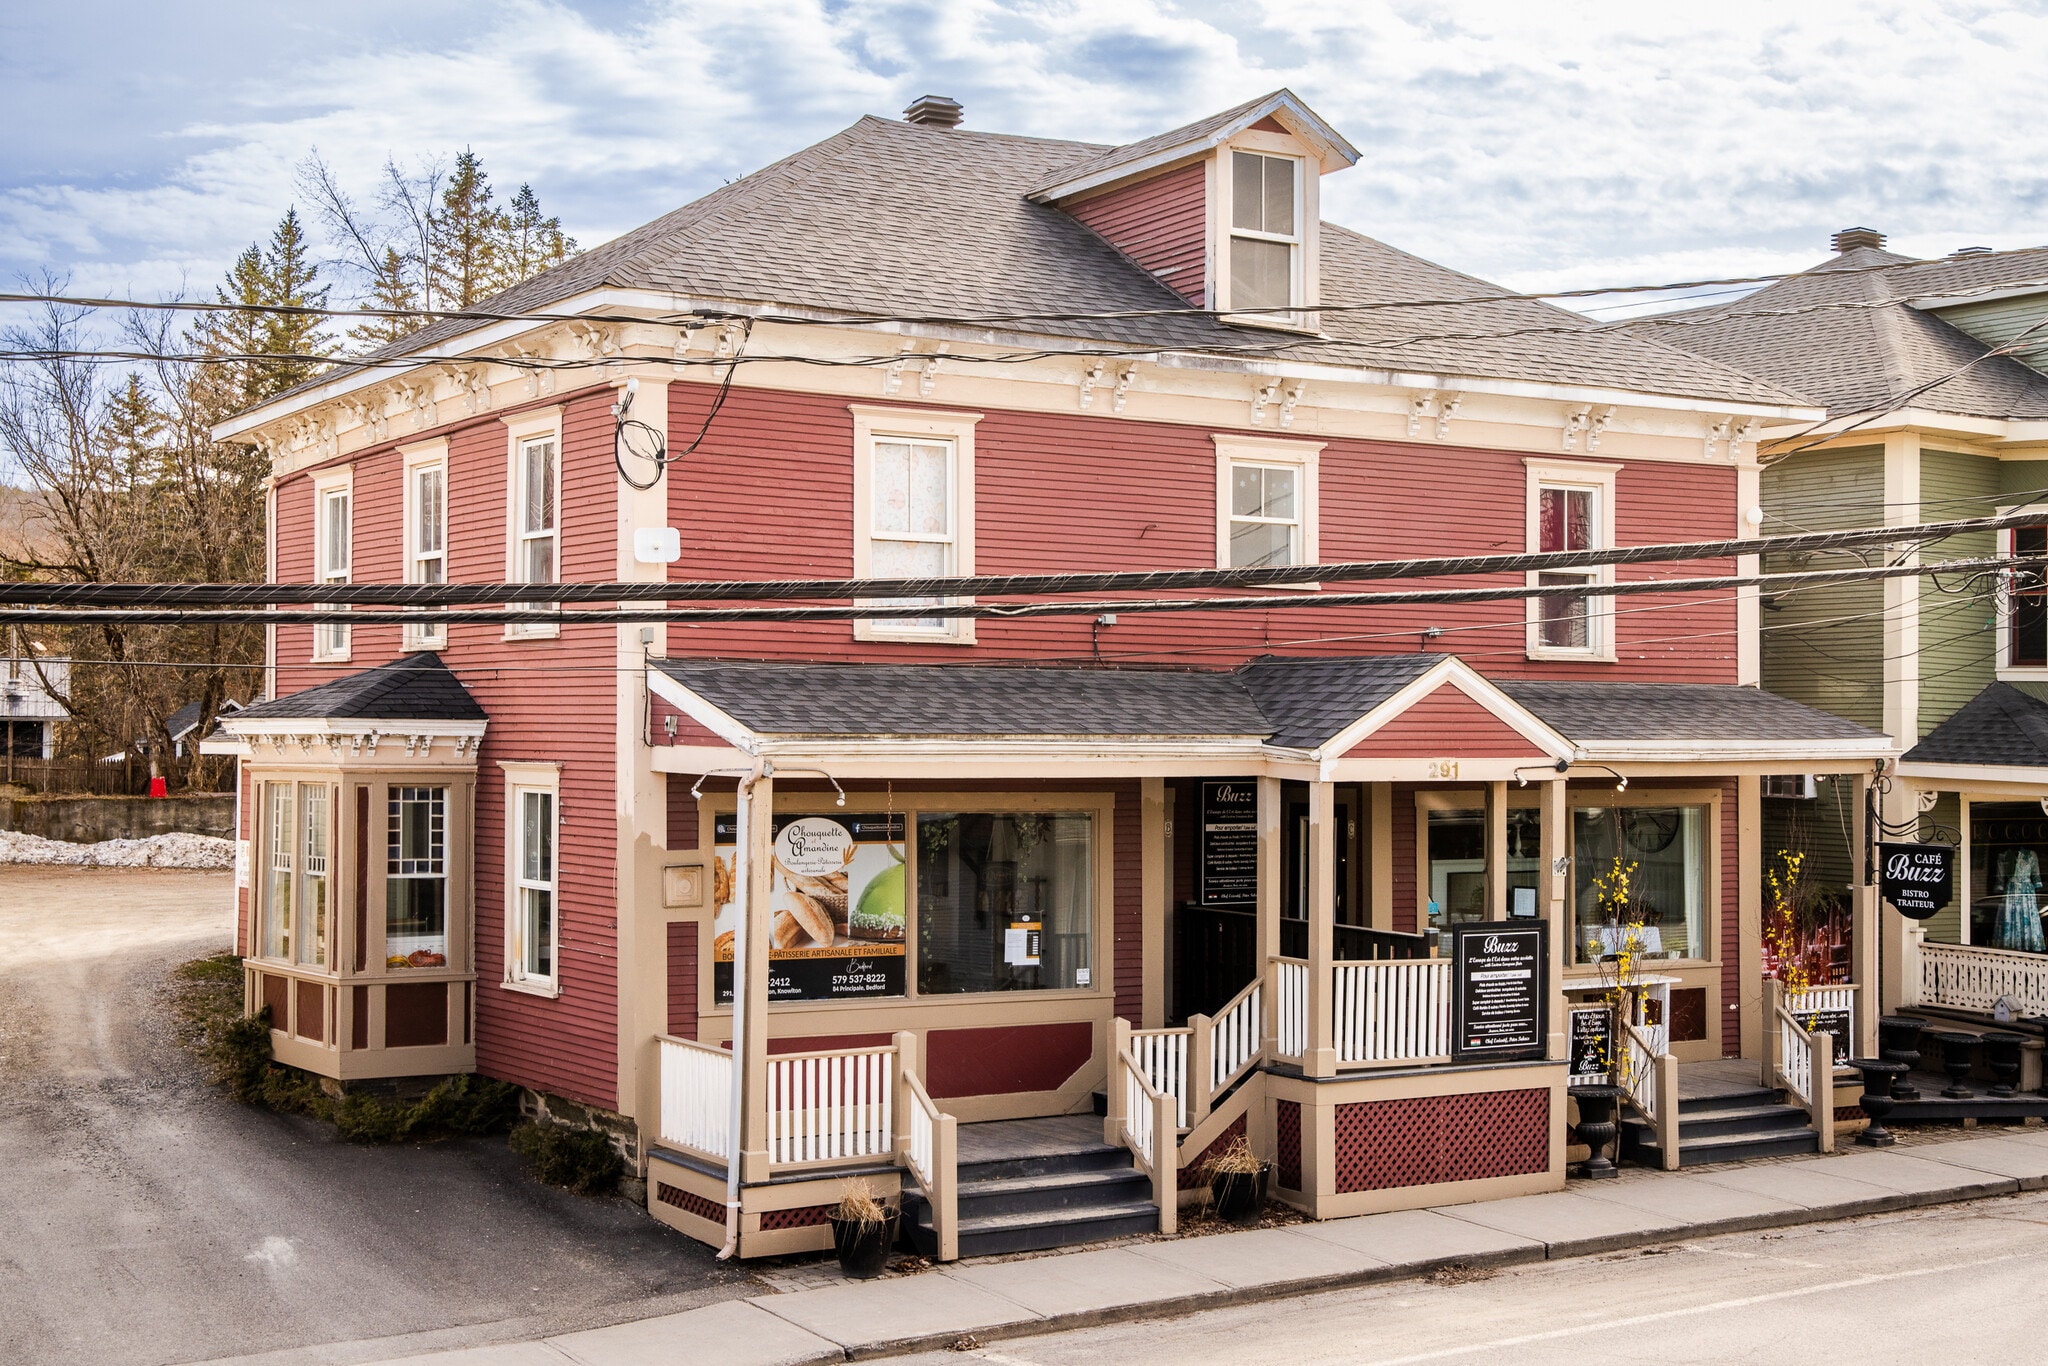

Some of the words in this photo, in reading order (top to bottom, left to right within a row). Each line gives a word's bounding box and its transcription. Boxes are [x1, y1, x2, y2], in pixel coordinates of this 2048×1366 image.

[1428, 761, 1459, 779] 291
[1216, 785, 1252, 802] Buzz
[788, 825, 843, 845] Chouquette
[791, 837, 839, 857] Amandine
[1914, 853, 1942, 865] CAFÉ
[1885, 853, 1945, 883] Buzz
[1901, 889, 1930, 899] BISTRO
[1896, 898, 1935, 909] TRAITEUR
[1483, 935, 1520, 954] Buzz
[811, 949, 851, 958] ARTISANALE
[853, 948, 862, 956] ET
[863, 947, 898, 956] FAMILIALE
[768, 977, 791, 988] -2412
[832, 975, 848, 985] 579
[848, 973, 886, 984] 537-8222
[777, 987, 802, 995] Knowlton
